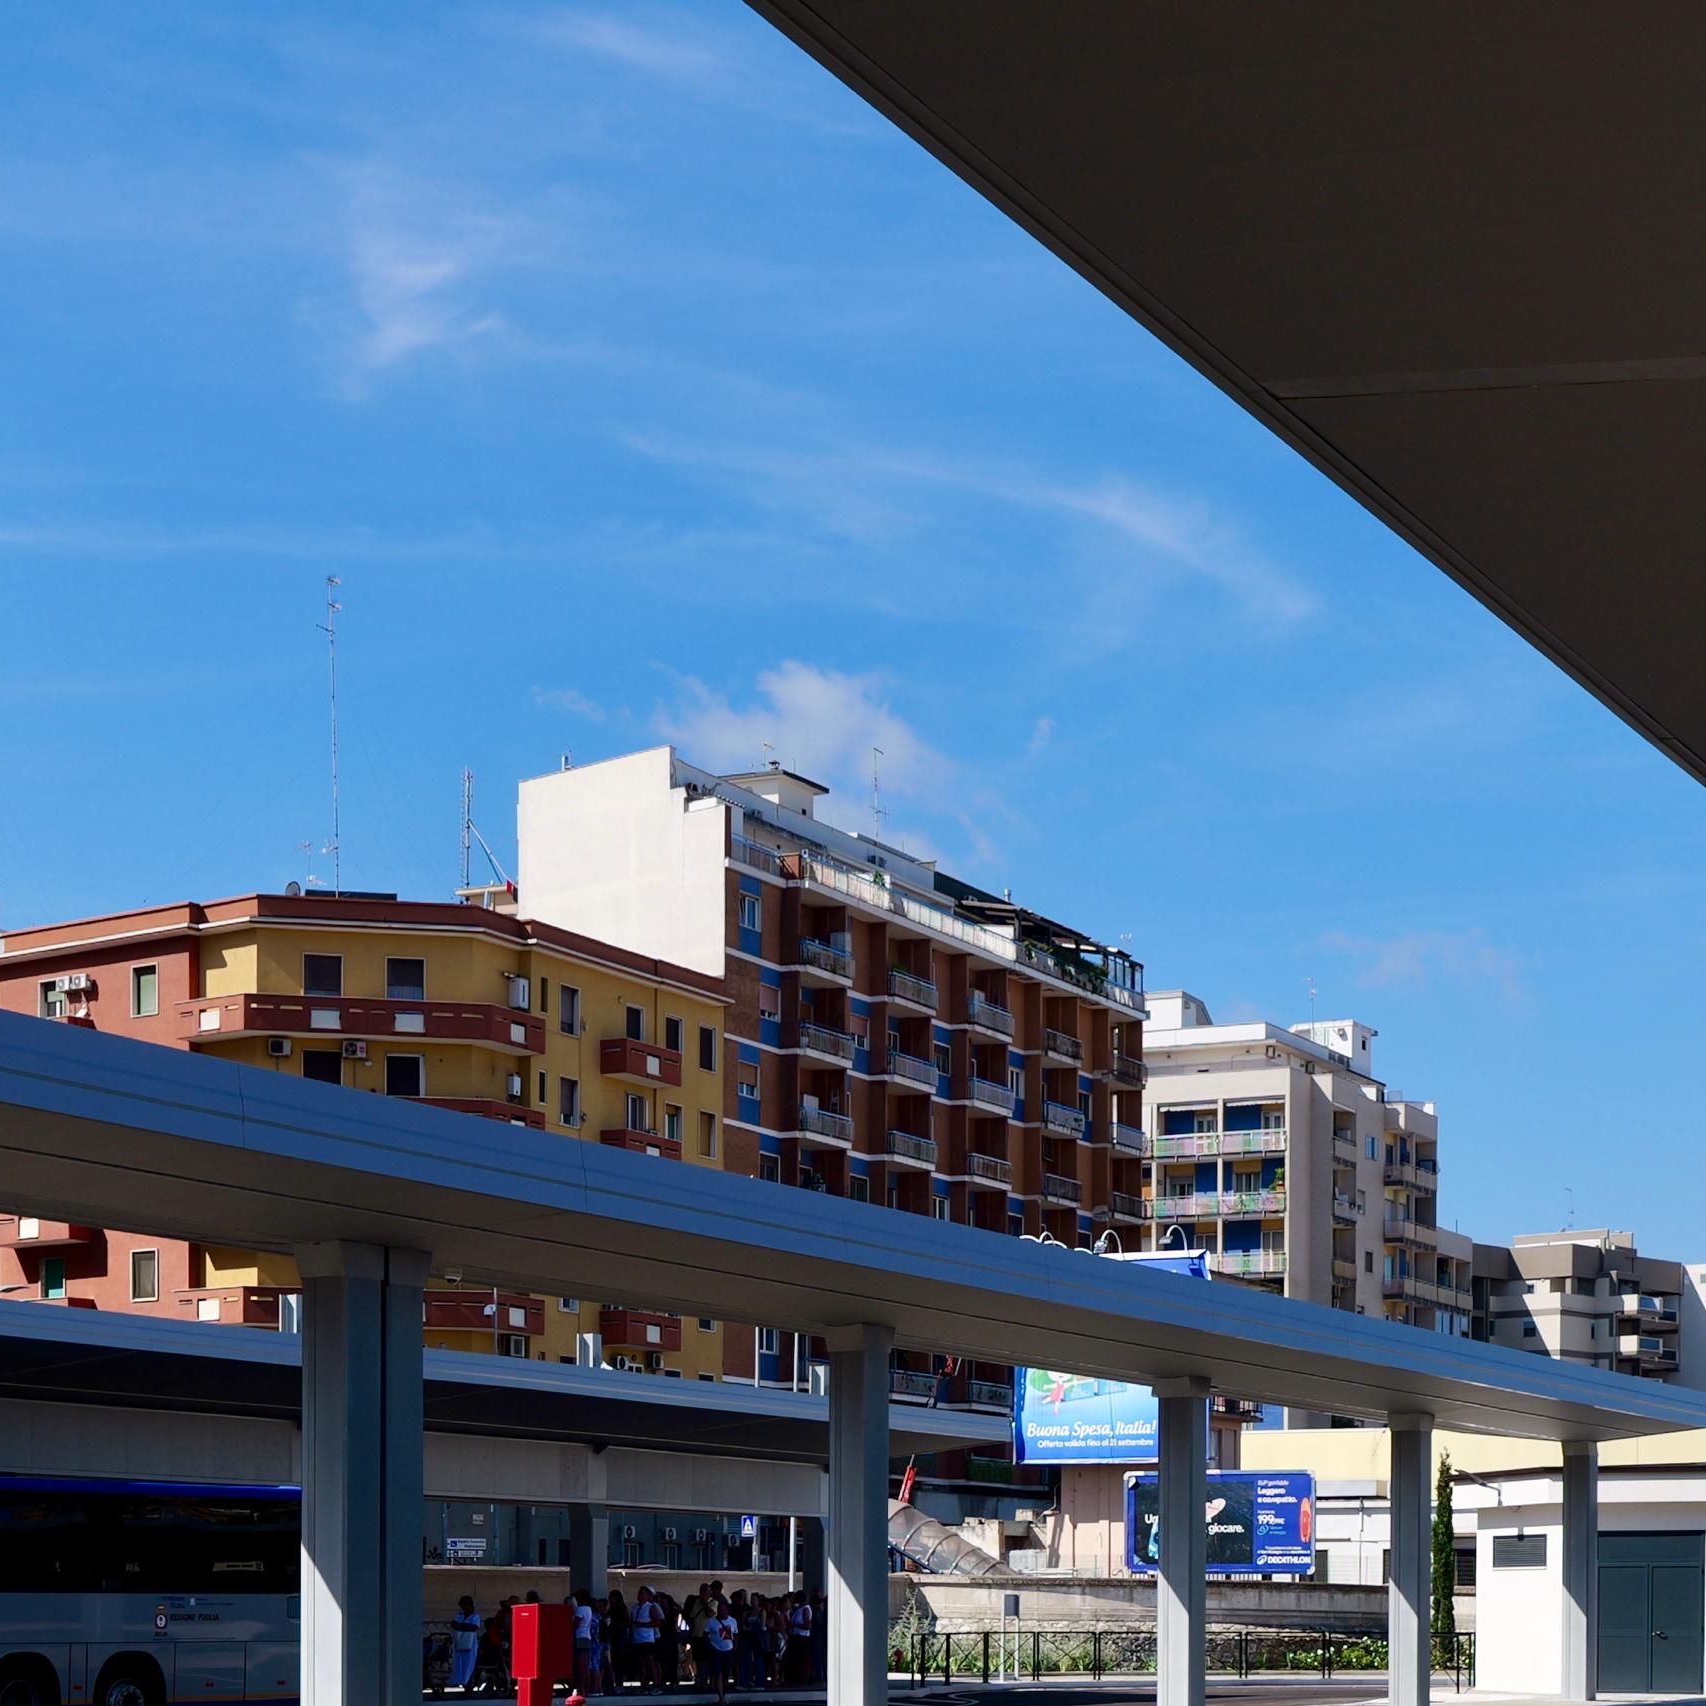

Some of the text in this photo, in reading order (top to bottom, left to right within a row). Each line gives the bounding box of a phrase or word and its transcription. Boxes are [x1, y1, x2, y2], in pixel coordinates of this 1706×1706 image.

[1027, 1419, 1157, 1438] Buona Spesa, Italia!
[1037, 1439, 1063, 1448] Offerta
[1064, 1439, 1086, 1448] valida
[1118, 1438, 1154, 1446] settembre
[1207, 1523, 1245, 1535] giocare.
[1267, 1556, 1311, 1564] DECATHLON
